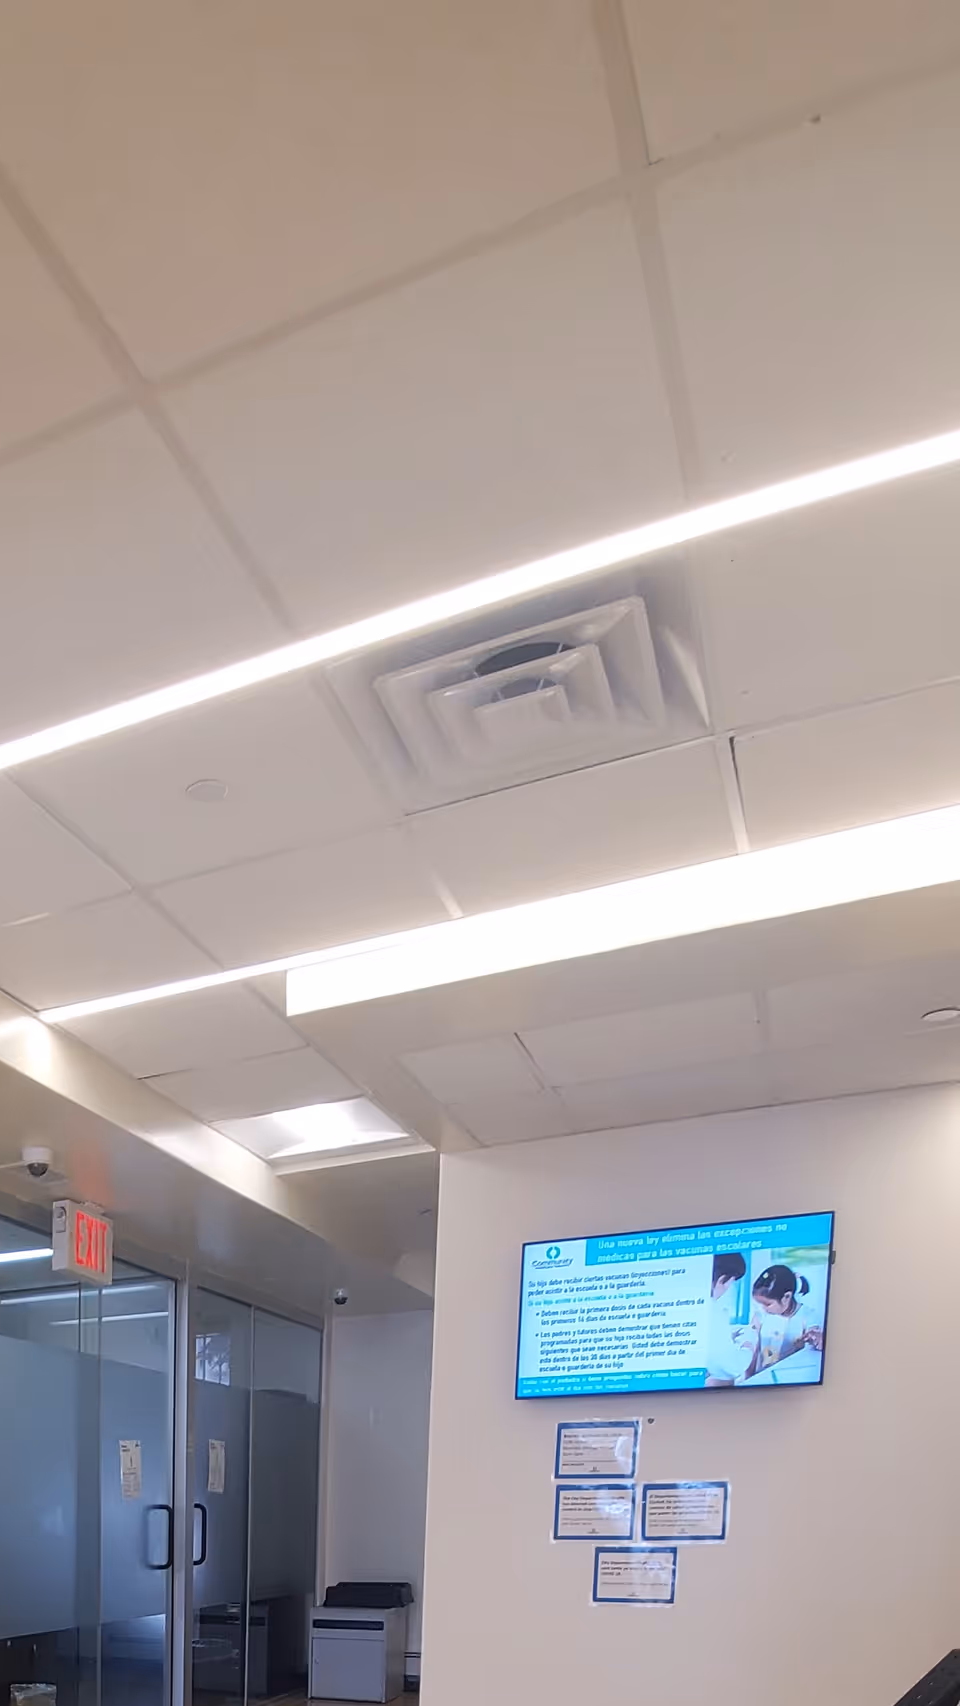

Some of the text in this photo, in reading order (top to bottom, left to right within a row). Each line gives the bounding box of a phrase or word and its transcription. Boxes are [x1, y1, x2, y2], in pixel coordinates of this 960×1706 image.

[76, 1210, 107, 1273] EXIT
[598, 1239, 614, 1249] Una
[617, 1238, 643, 1246] nueva
[775, 1223, 787, 1231] no
[636, 1250, 656, 1262] para
[659, 1247, 672, 1256] las
[675, 1245, 713, 1255] vacunas
[716, 1238, 762, 1251] escolares
